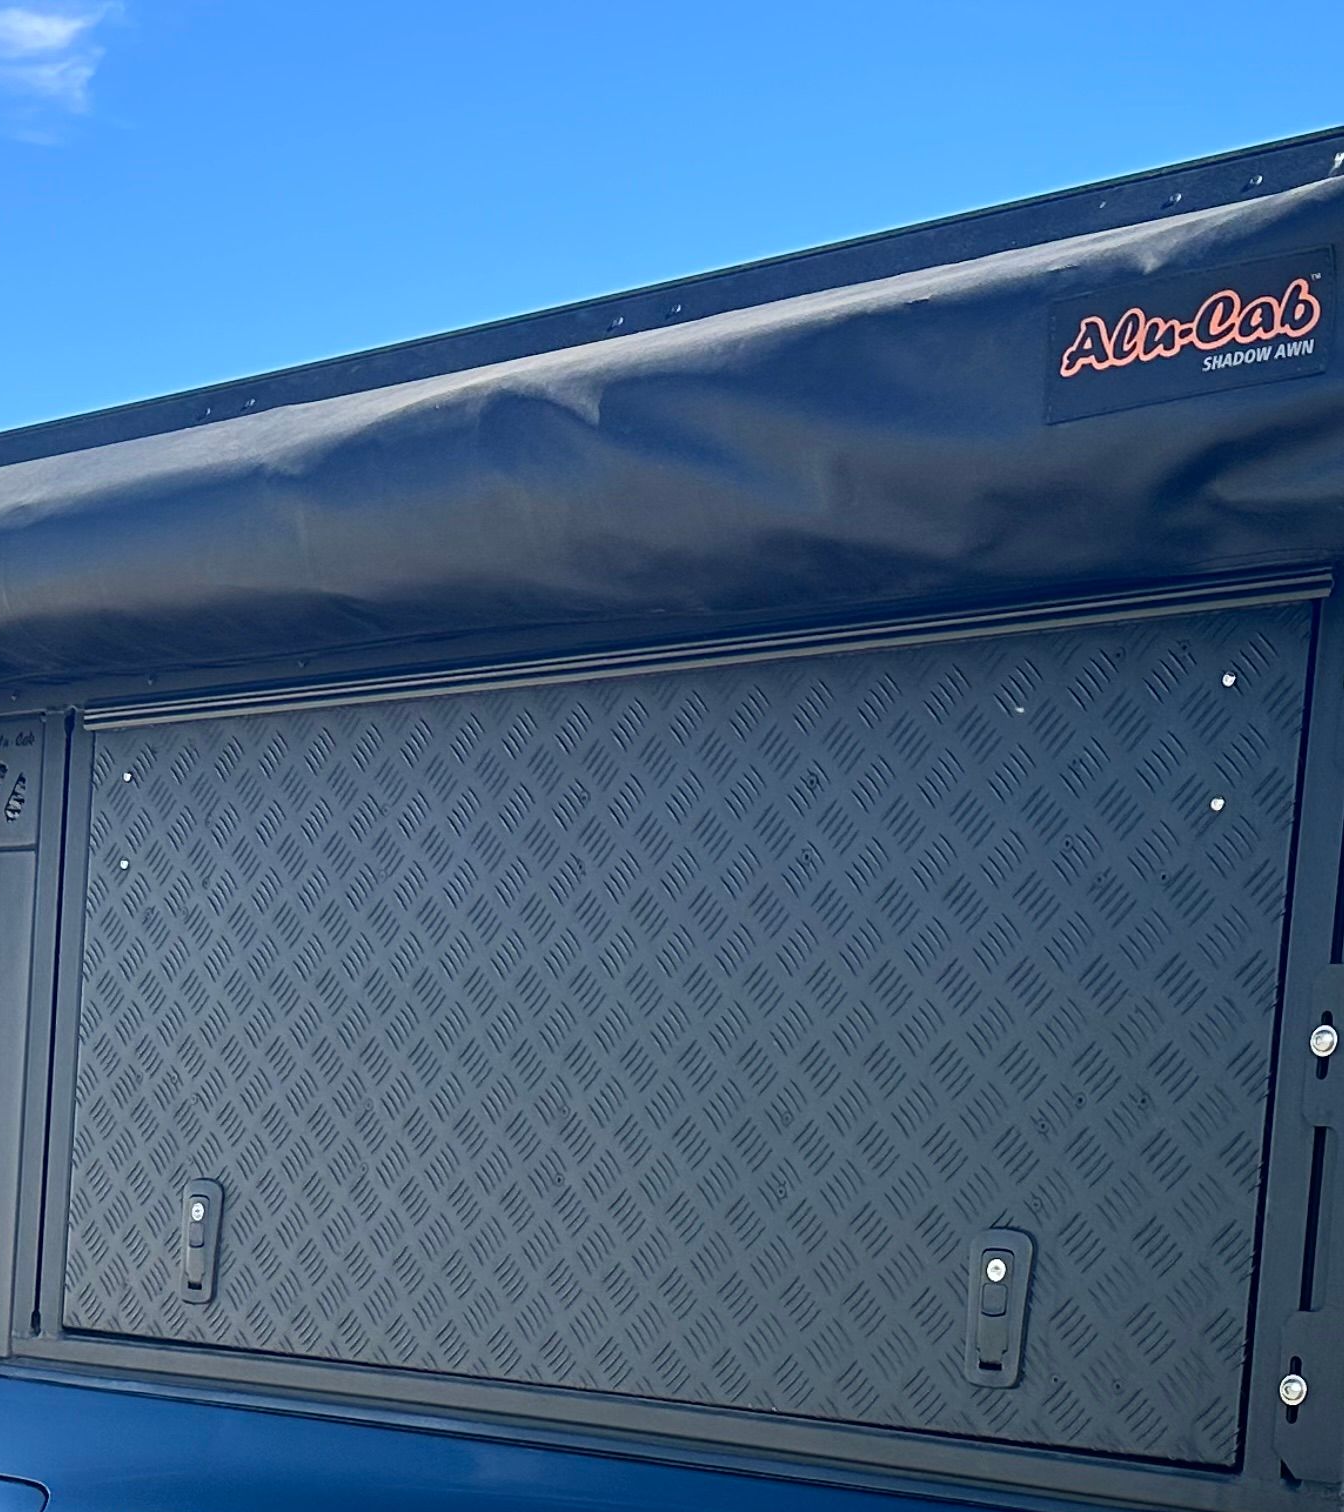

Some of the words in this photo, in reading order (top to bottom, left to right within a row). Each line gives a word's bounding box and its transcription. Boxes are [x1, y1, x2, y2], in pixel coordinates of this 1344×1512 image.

[1059, 275, 1321, 378] Alu-Cab
[1202, 346, 1272, 372] SHADOW
[1274, 338, 1315, 359] AWN
